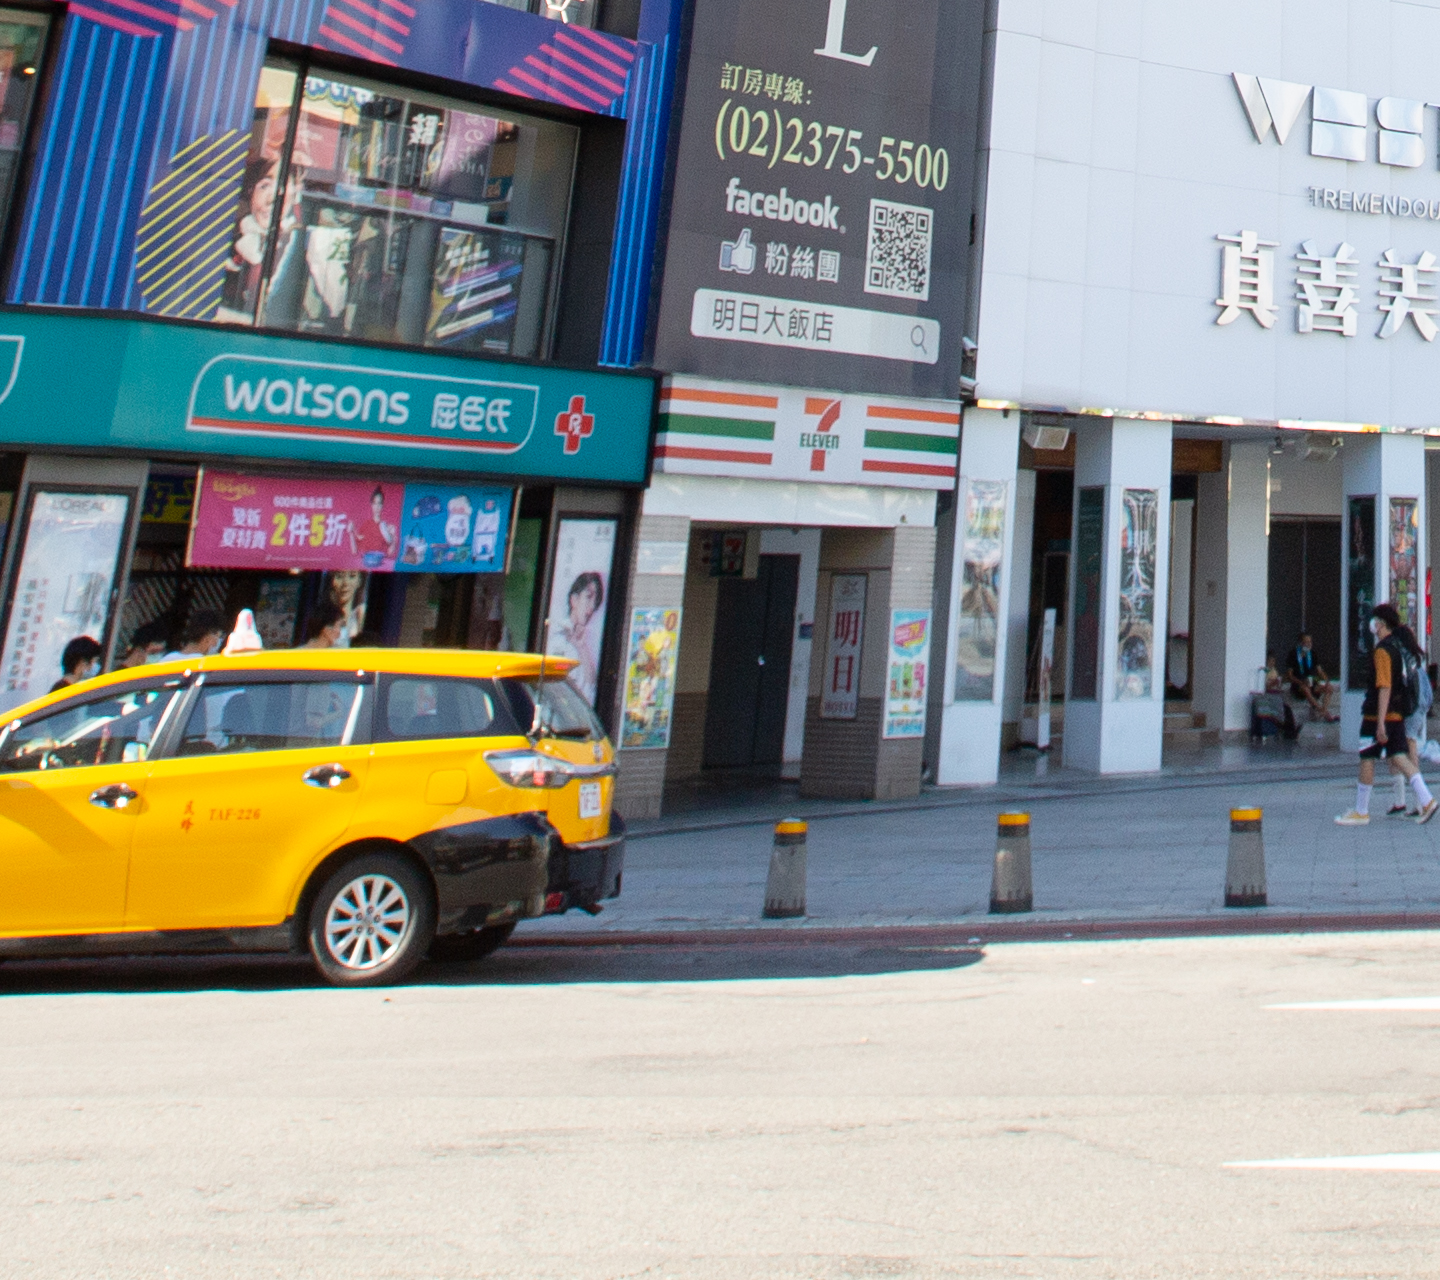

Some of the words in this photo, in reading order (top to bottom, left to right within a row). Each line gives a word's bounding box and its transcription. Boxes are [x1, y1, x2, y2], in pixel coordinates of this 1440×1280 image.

[715, 98, 950, 191] (02)2375-5500
[726, 177, 839, 231] facebook
[764, 241, 841, 284] 粉絲團
[712, 297, 835, 343] 明日大飯店
[224, 372, 409, 427] watsons
[432, 393, 513, 435] 屈臣氏
[270, 512, 348, 548] 2件5折
